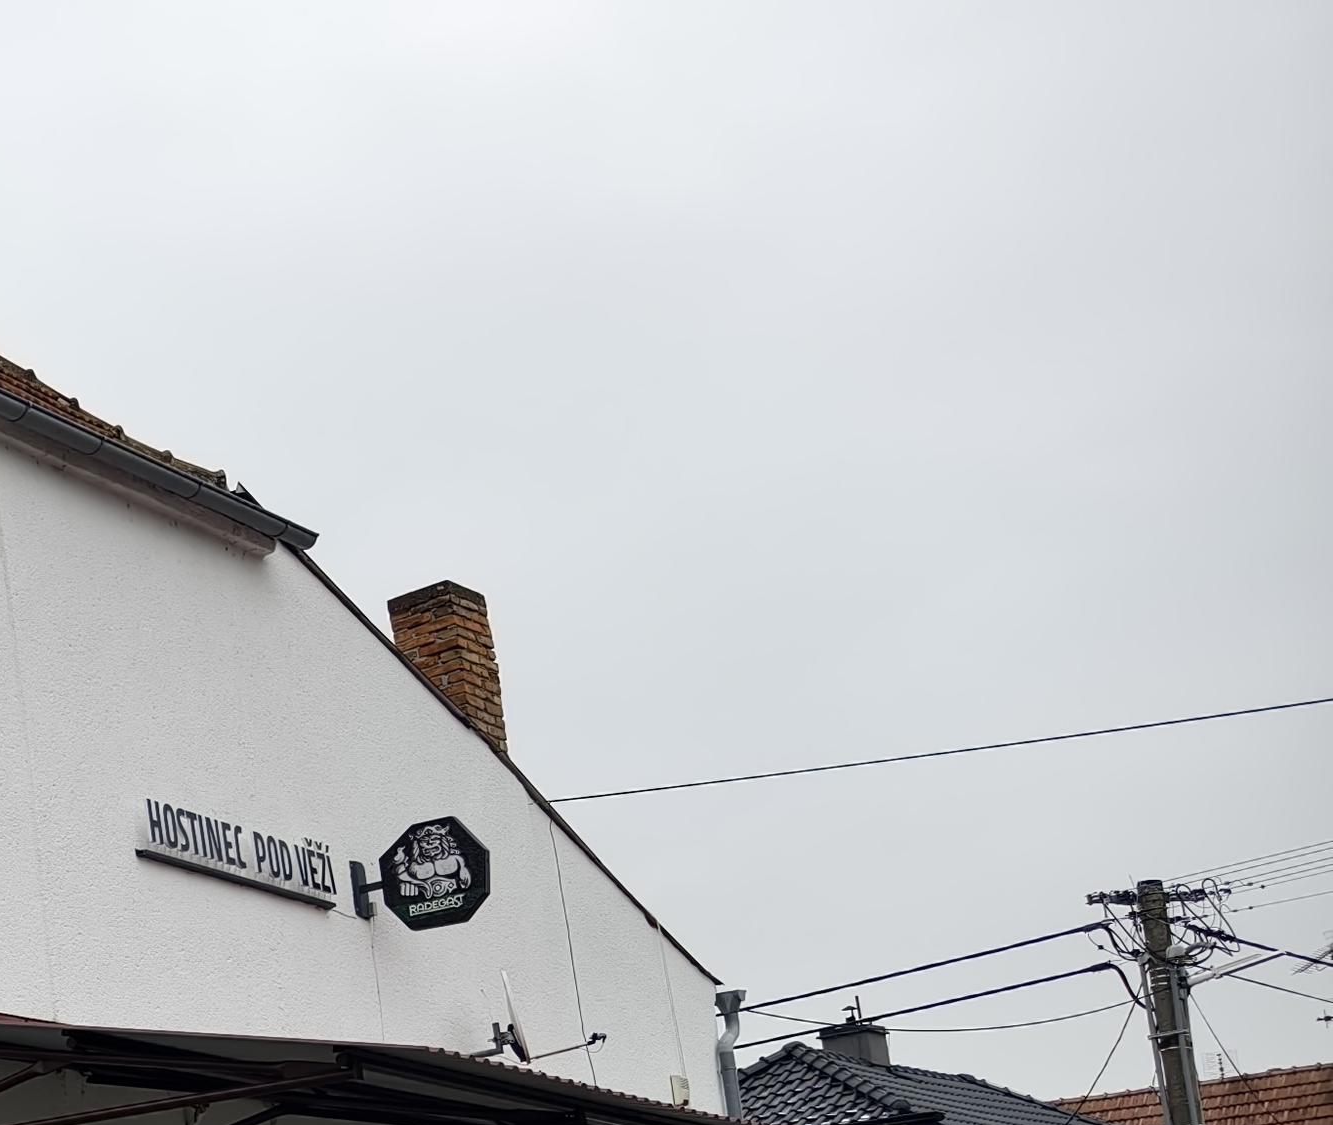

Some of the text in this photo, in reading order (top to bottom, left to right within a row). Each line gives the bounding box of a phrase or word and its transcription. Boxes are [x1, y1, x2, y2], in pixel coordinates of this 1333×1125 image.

[146, 798, 337, 895] HOSTINEC POD VĚŽÍ
[409, 893, 465, 917] RADEGAST
